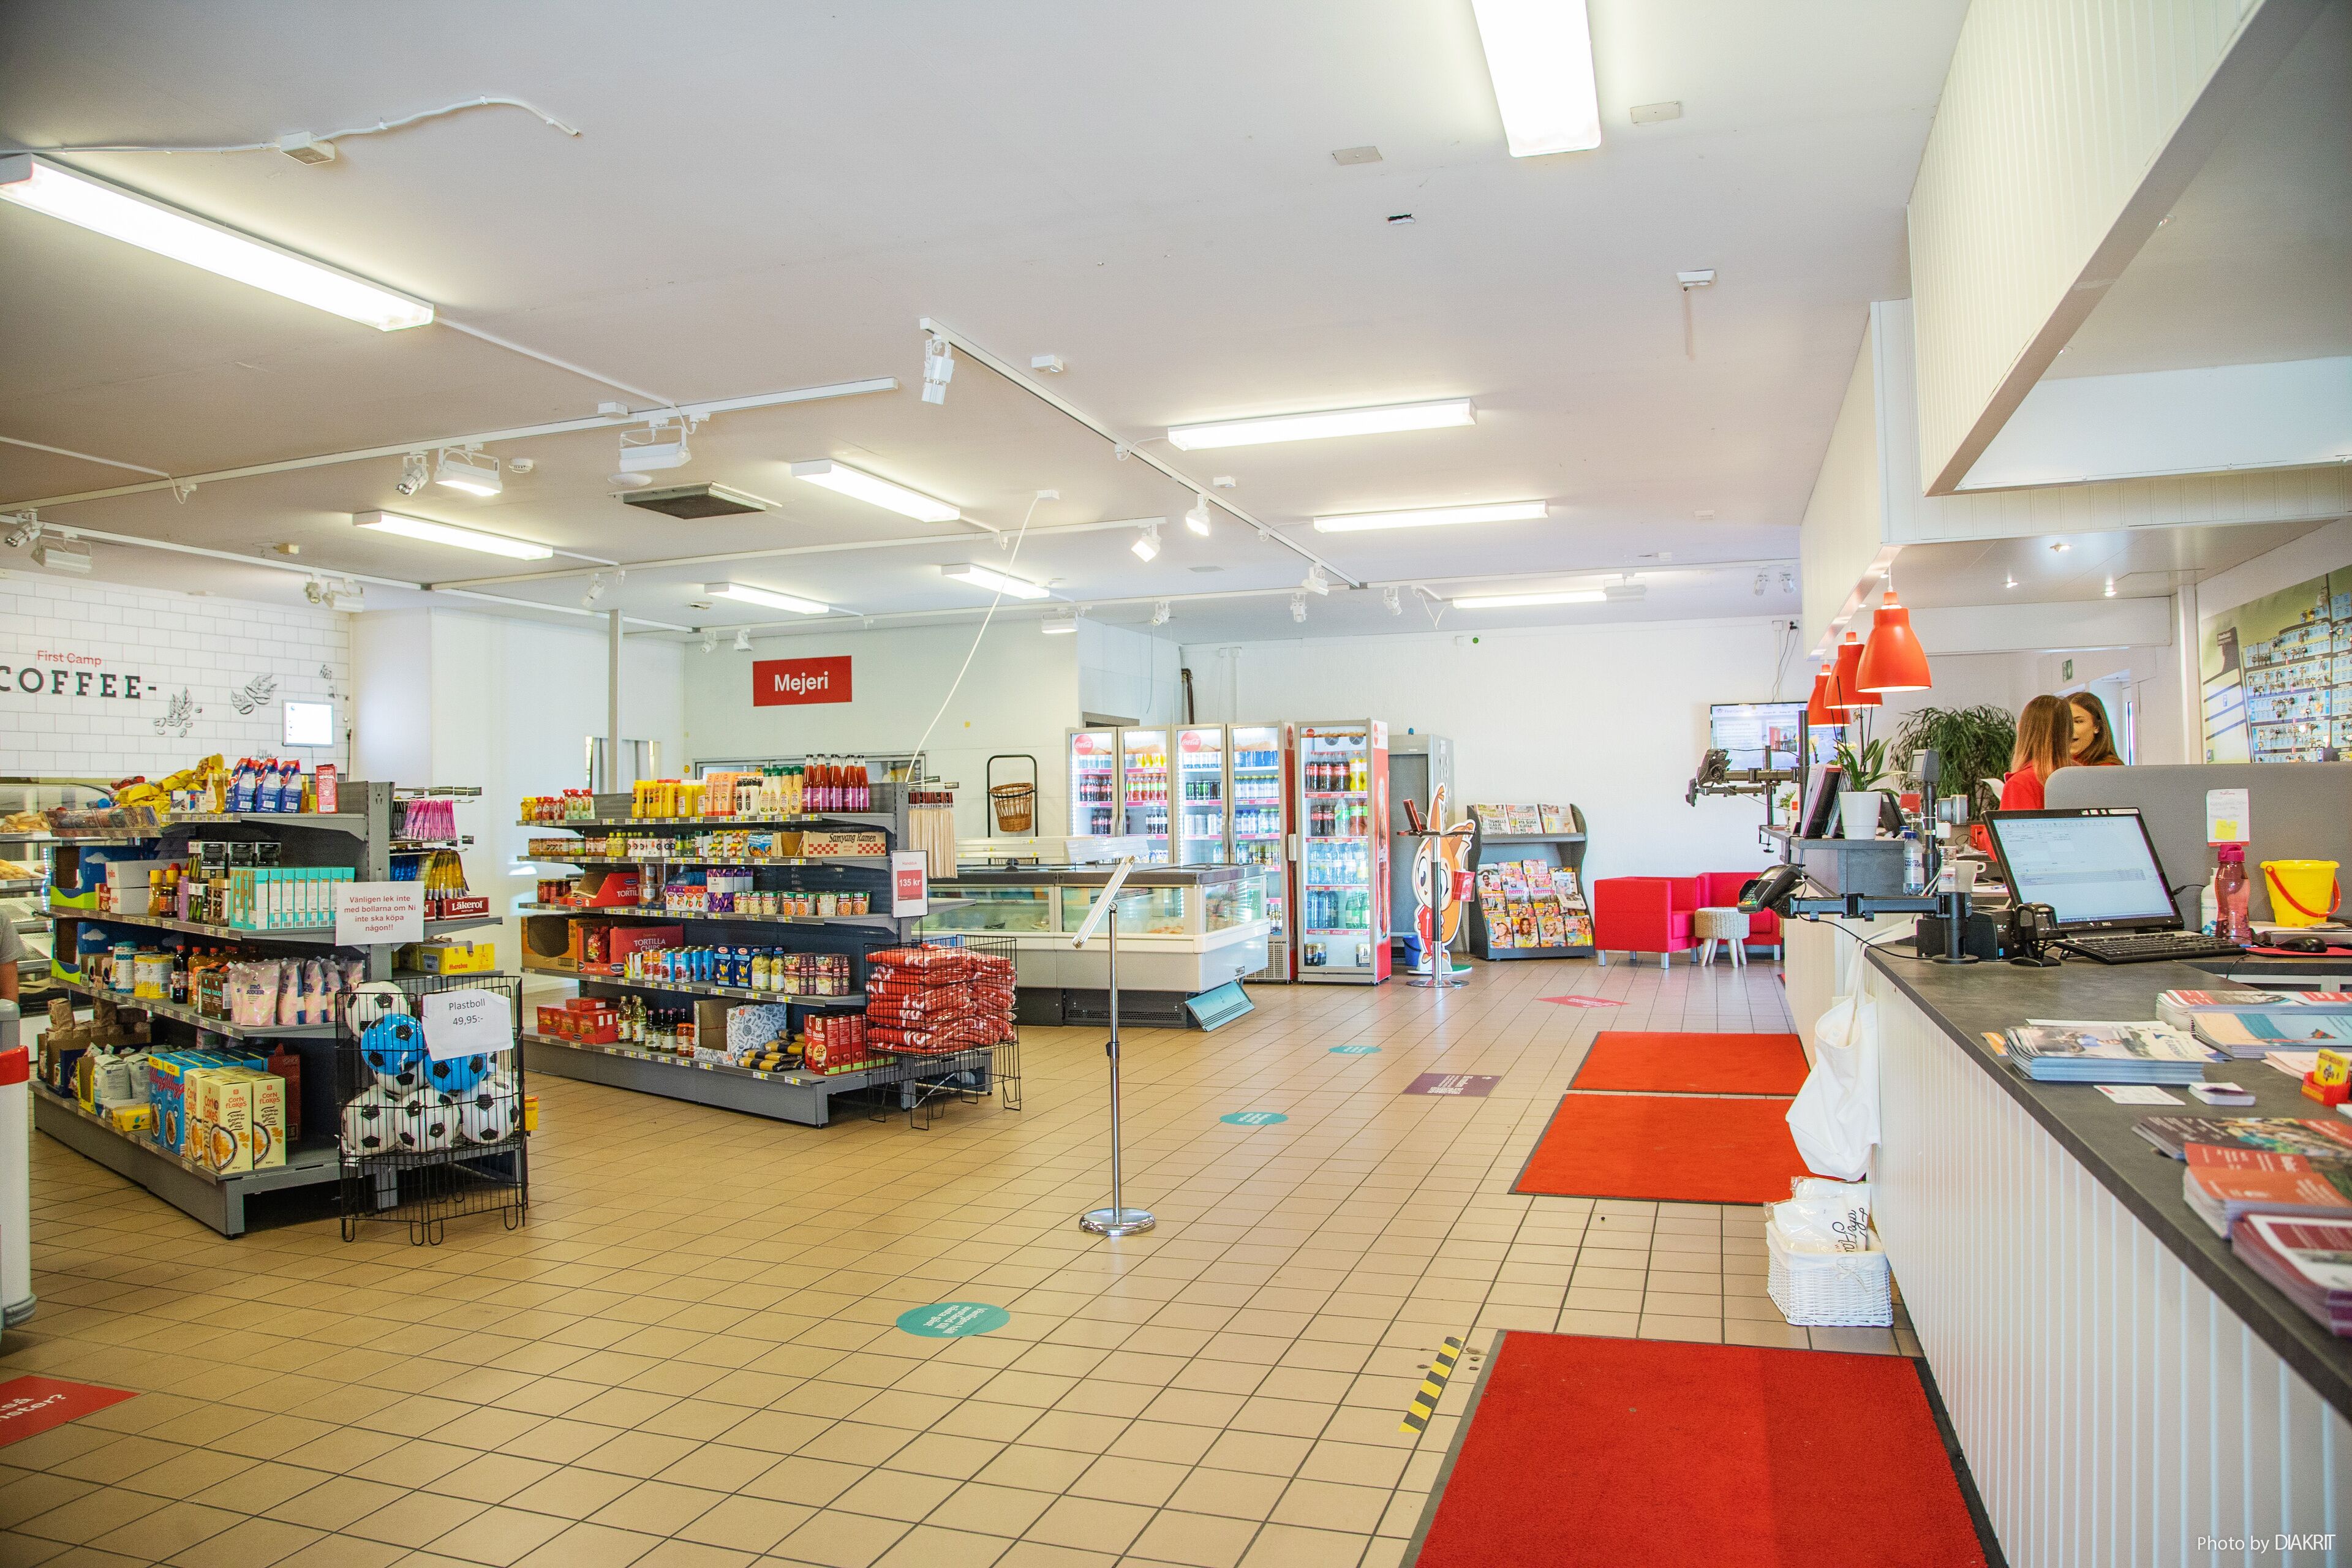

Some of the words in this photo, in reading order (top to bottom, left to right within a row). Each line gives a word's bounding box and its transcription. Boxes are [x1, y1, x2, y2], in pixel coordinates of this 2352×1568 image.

[37, 650, 64, 662] First
[67, 653, 102, 667] Camp
[774, 671, 829, 695] Mejeri
[829, 834, 856, 843] Samyang
[856, 832, 876, 843] Ramen
[899, 878, 912, 887] 135
[913, 878, 921, 886] kr
[350, 895, 381, 905] Vänligen
[451, 901, 483, 911] Läkerol
[365, 924, 394, 933] någon!!
[633, 938, 666, 947] TORTILLA
[449, 998, 486, 1011] Plastboll
[453, 1014, 484, 1026] 49,95:-
